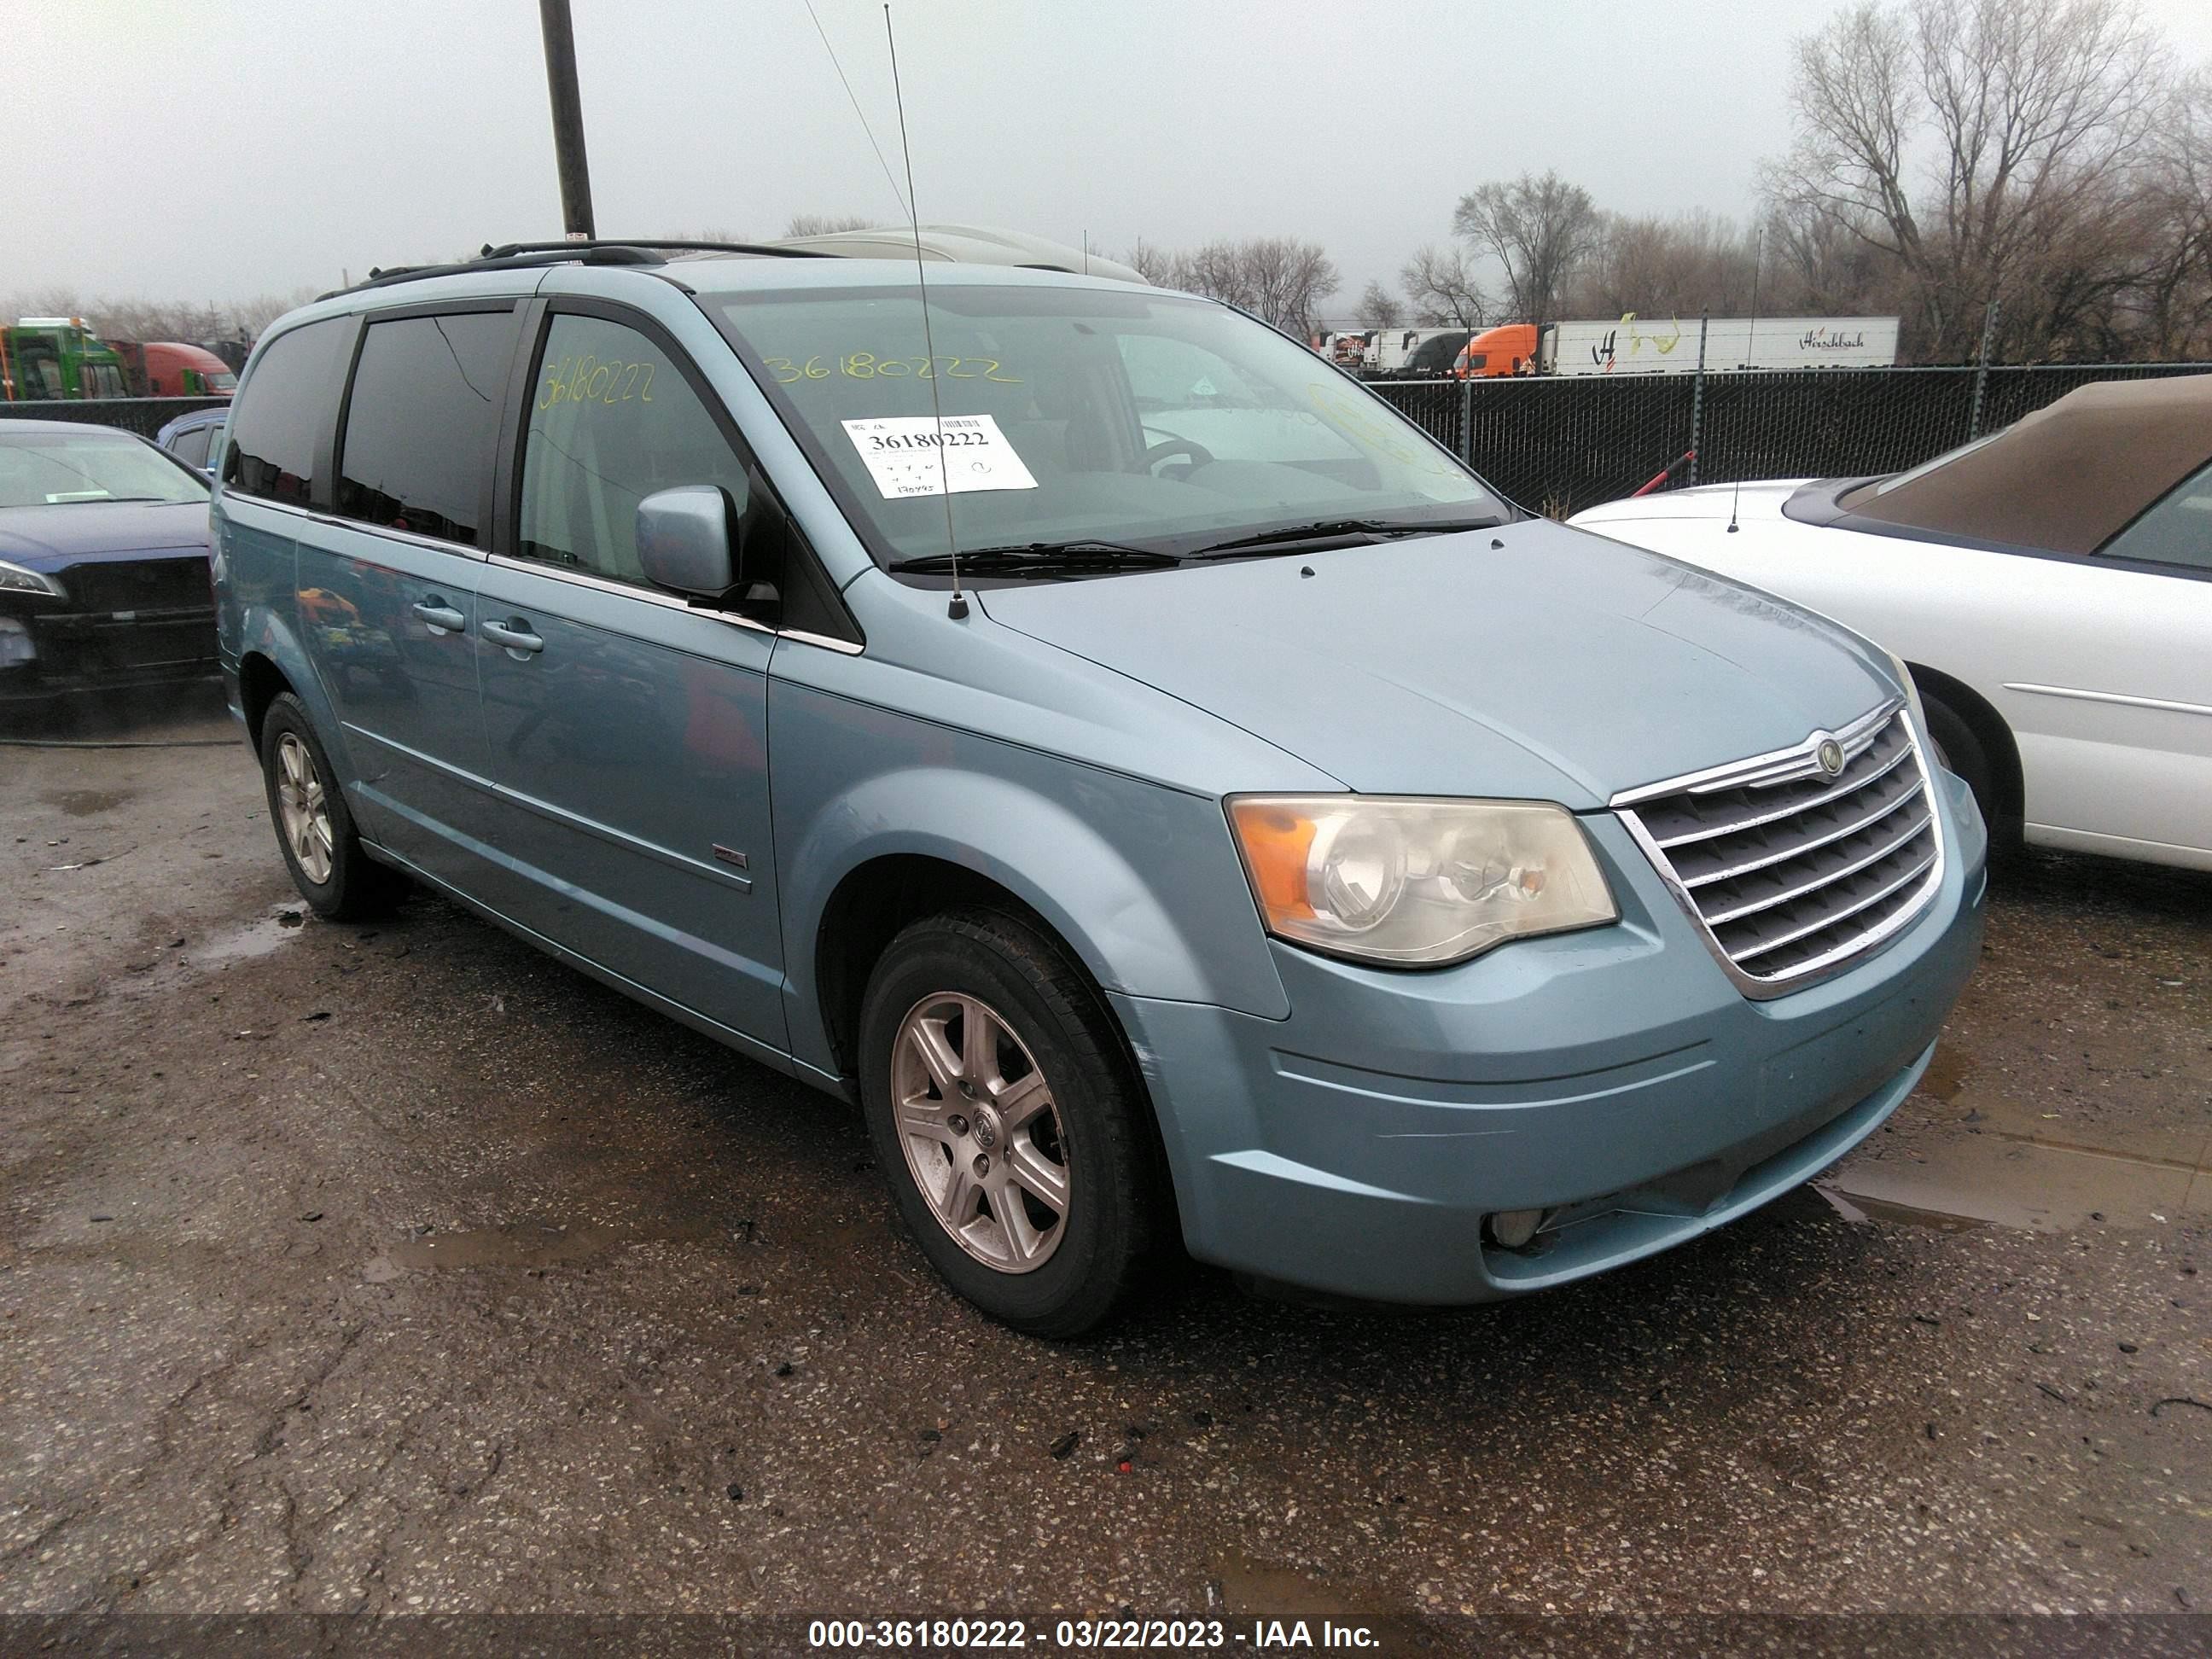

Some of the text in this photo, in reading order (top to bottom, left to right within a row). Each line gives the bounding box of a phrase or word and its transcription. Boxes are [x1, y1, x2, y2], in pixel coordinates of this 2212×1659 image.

[1799, 329, 1864, 350] Hirschbach
[763, 352, 1024, 383] 36180222
[539, 355, 655, 410] 36180222
[869, 432, 988, 451] 36180222
